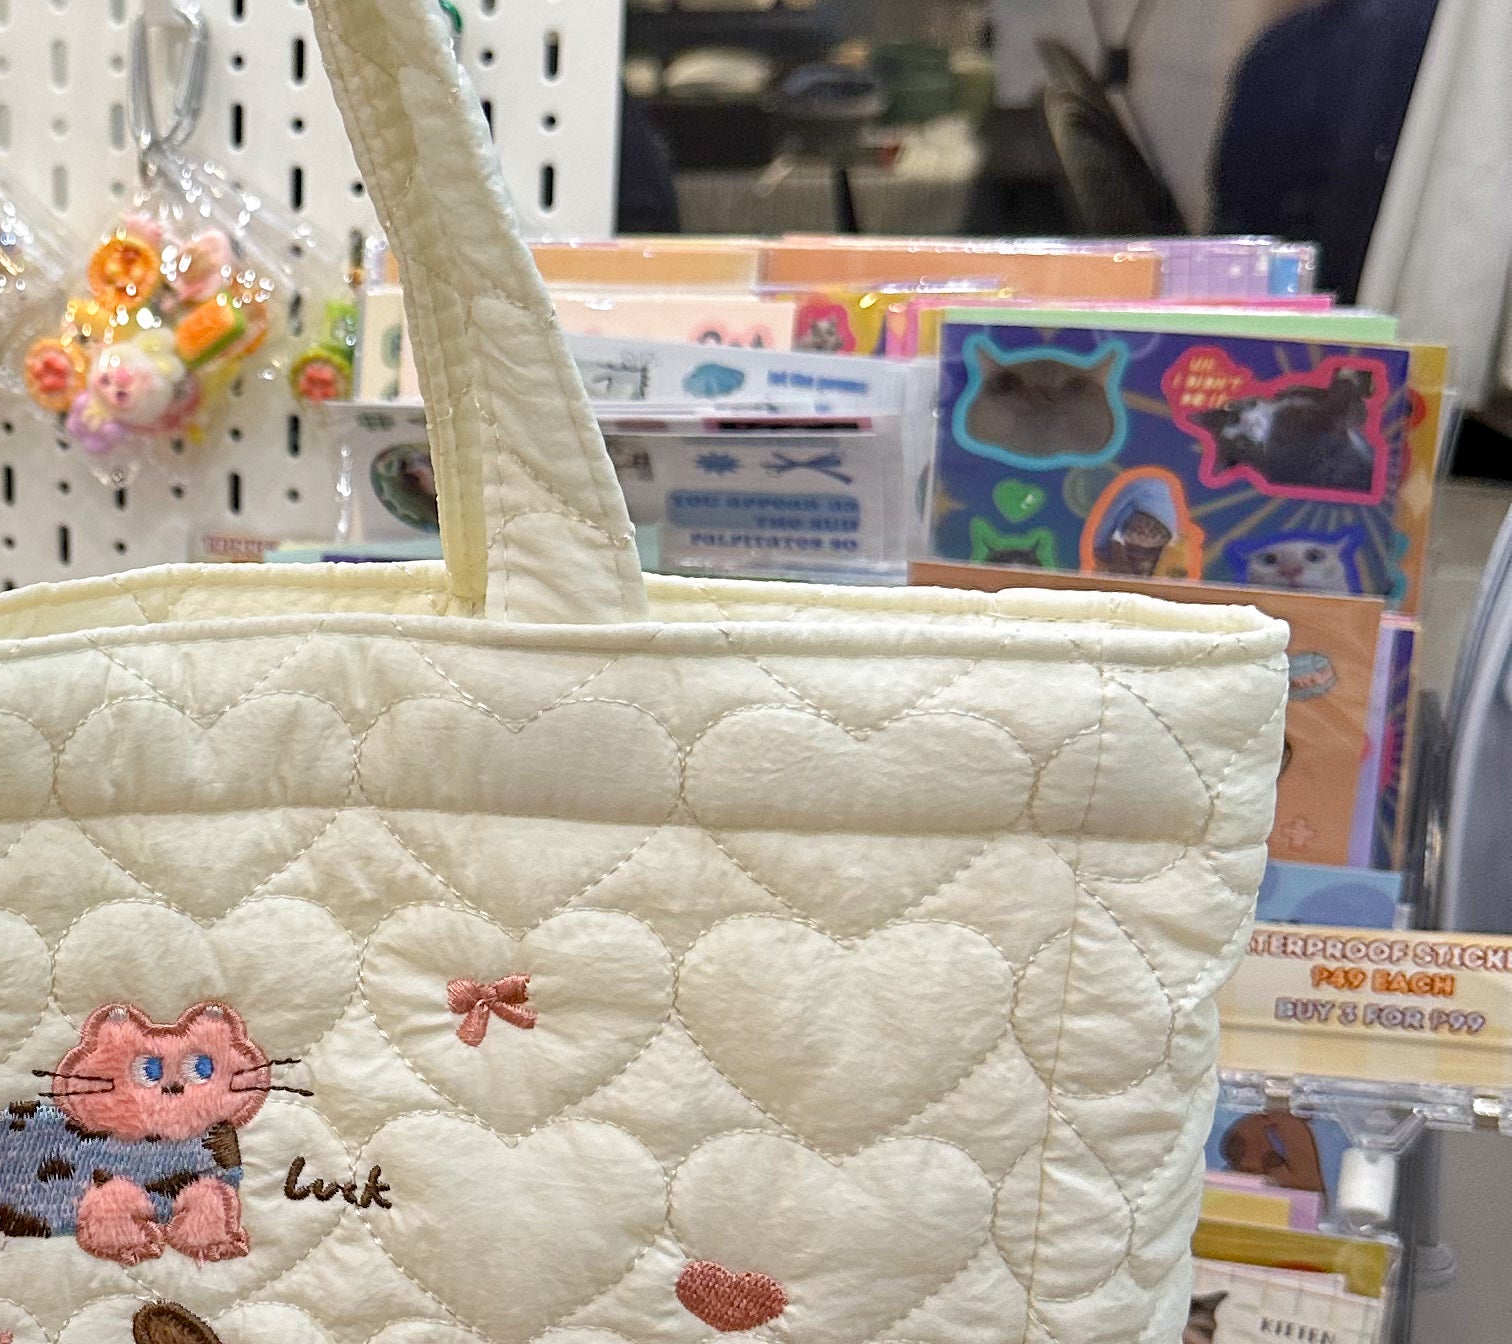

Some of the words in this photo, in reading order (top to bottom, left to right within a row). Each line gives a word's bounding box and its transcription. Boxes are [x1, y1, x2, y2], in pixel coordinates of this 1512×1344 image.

[1246, 930, 1409, 964] TERPROOF
[1371, 967, 1457, 998] EACH
[1274, 996, 1335, 1022] BUY
[1338, 1001, 1358, 1026] 3
[1362, 1002, 1424, 1030] FOR
